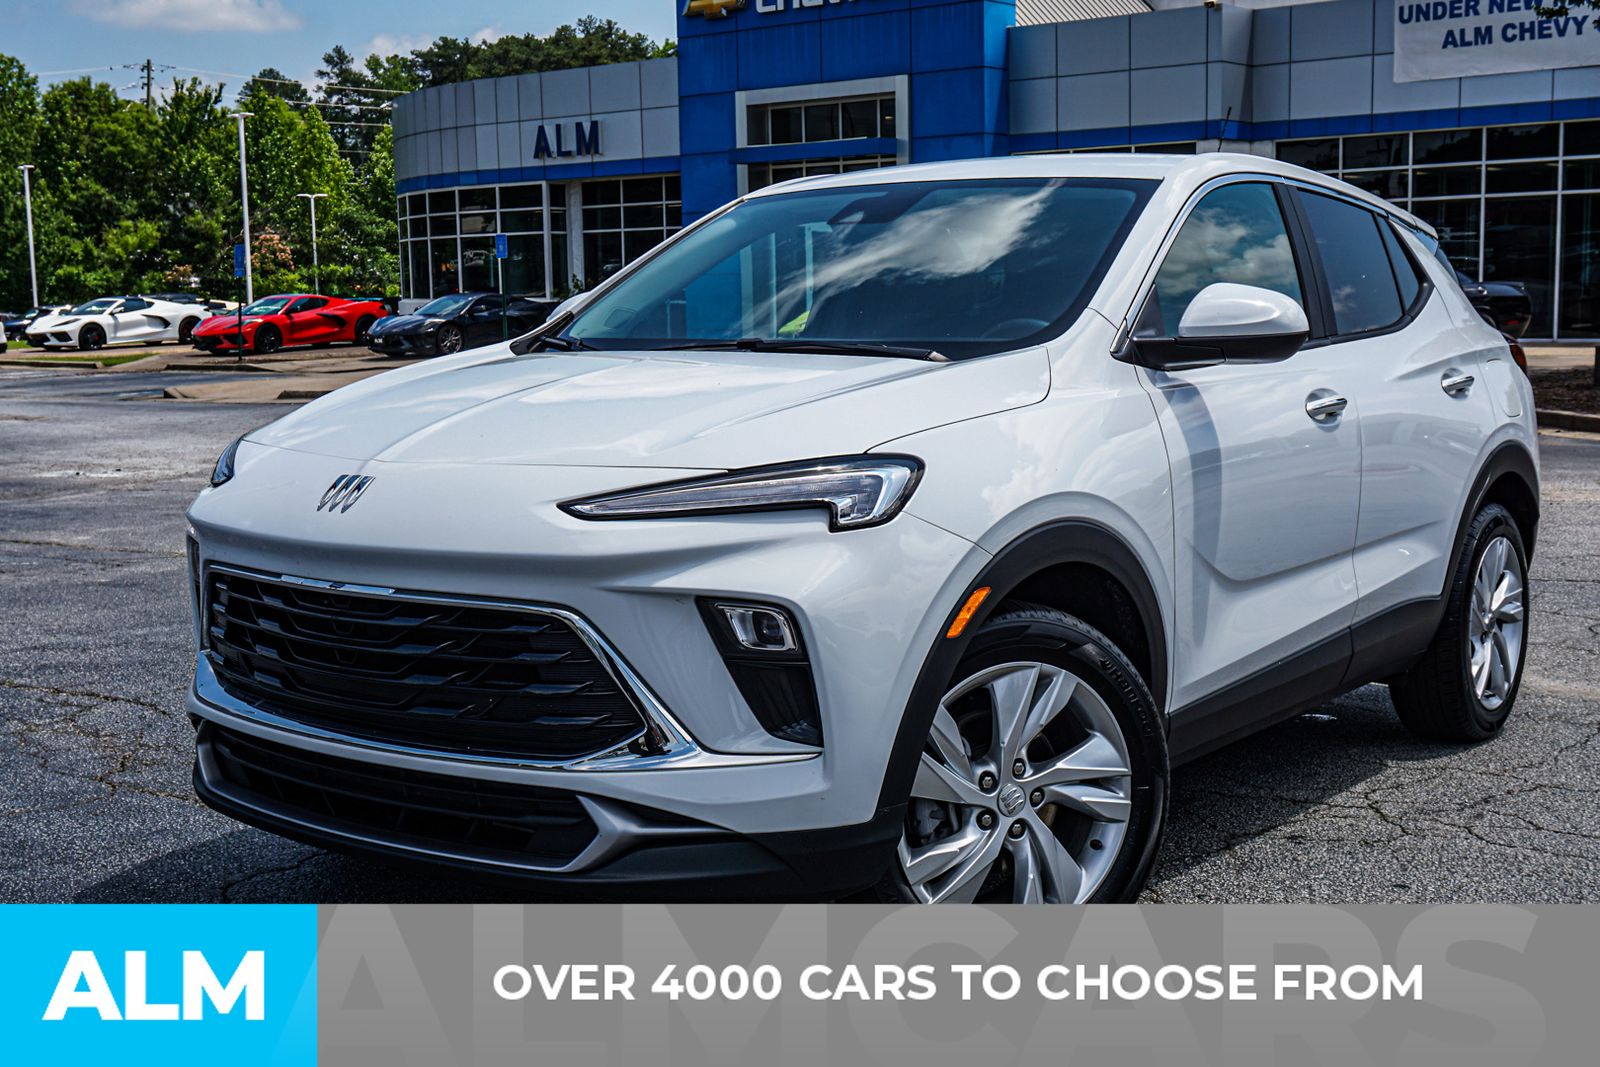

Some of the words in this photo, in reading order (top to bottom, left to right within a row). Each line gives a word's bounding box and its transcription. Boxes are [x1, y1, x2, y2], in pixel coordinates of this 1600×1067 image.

[1397, 0, 1480, 25] UNDER
[1441, 25, 1493, 49] ALM
[1501, 14, 1590, 43] CHEVY
[533, 120, 600, 159] ALM
